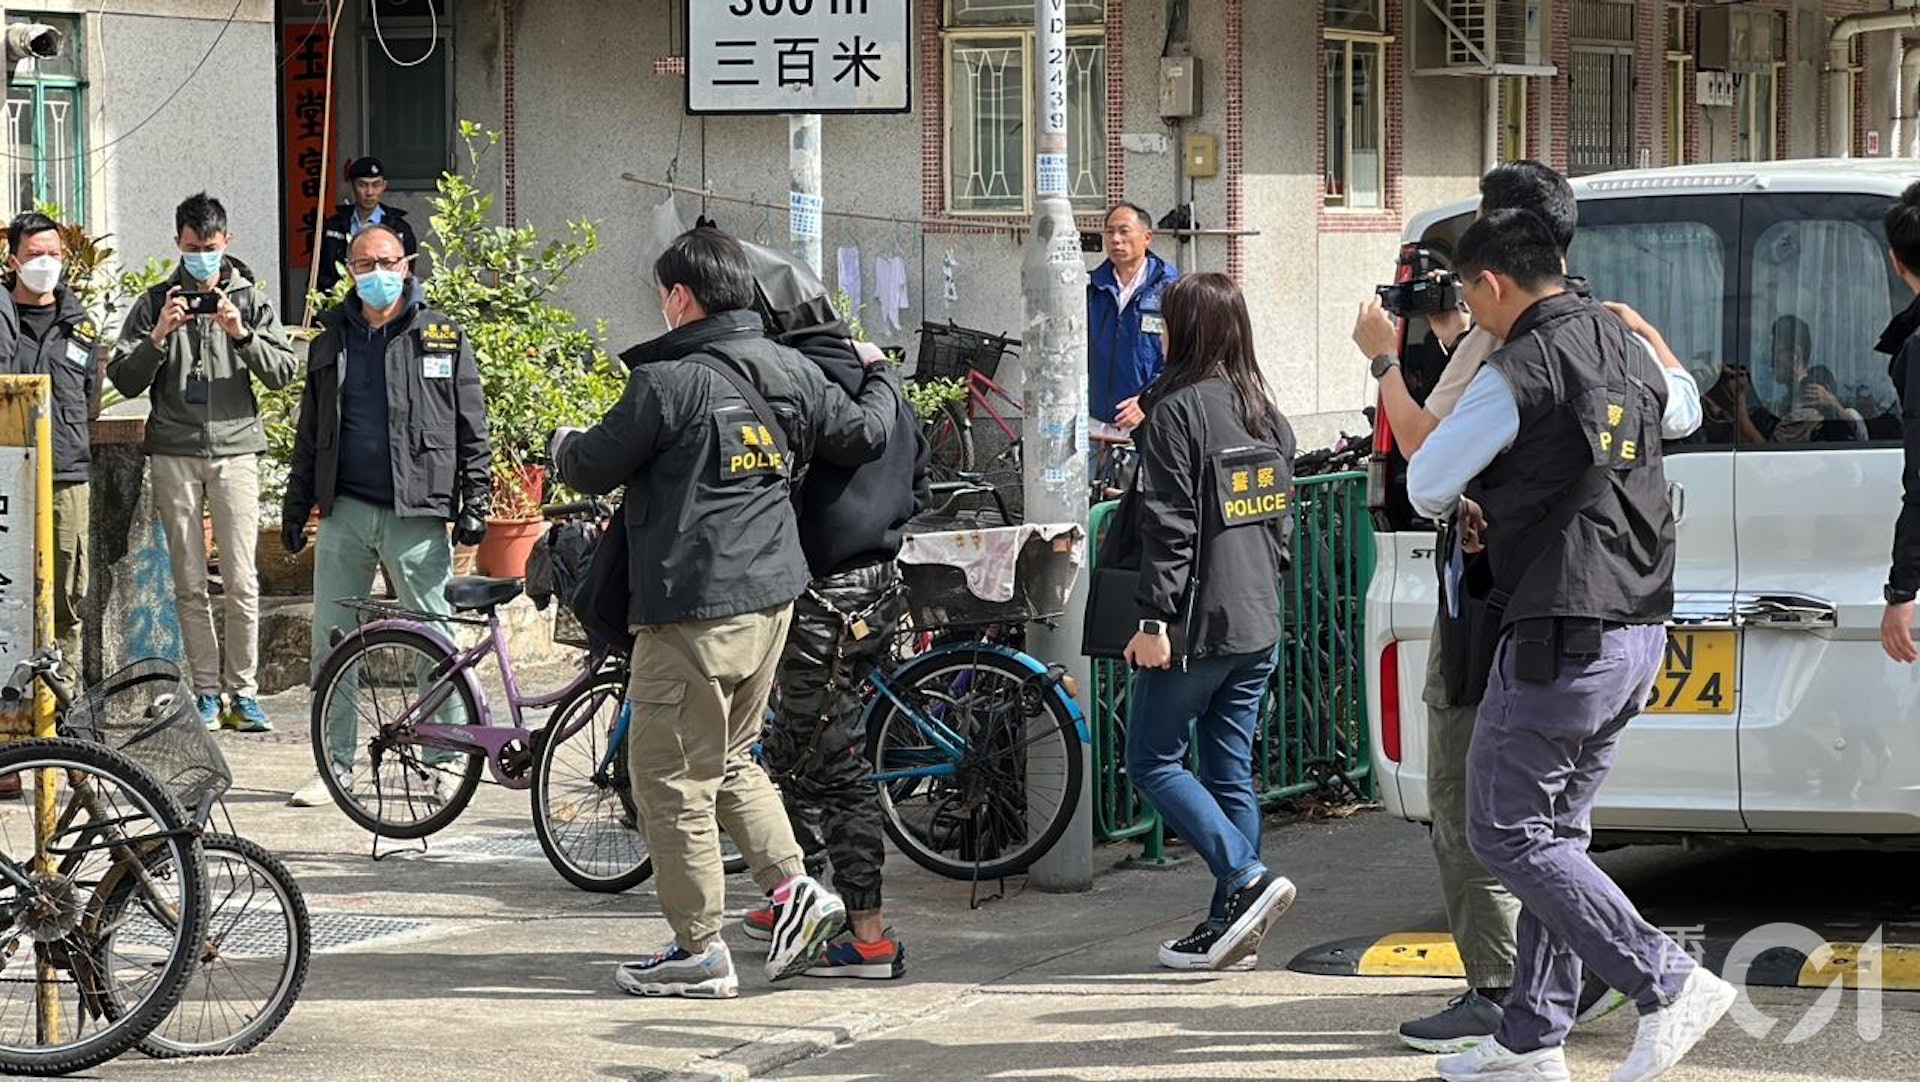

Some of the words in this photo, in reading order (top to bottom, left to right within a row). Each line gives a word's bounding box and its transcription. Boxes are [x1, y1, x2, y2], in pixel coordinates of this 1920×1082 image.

[712, 35, 881, 87] 三百米
[1048, 48, 1063, 128] 2439
[1224, 493, 1287, 519] POLICE
